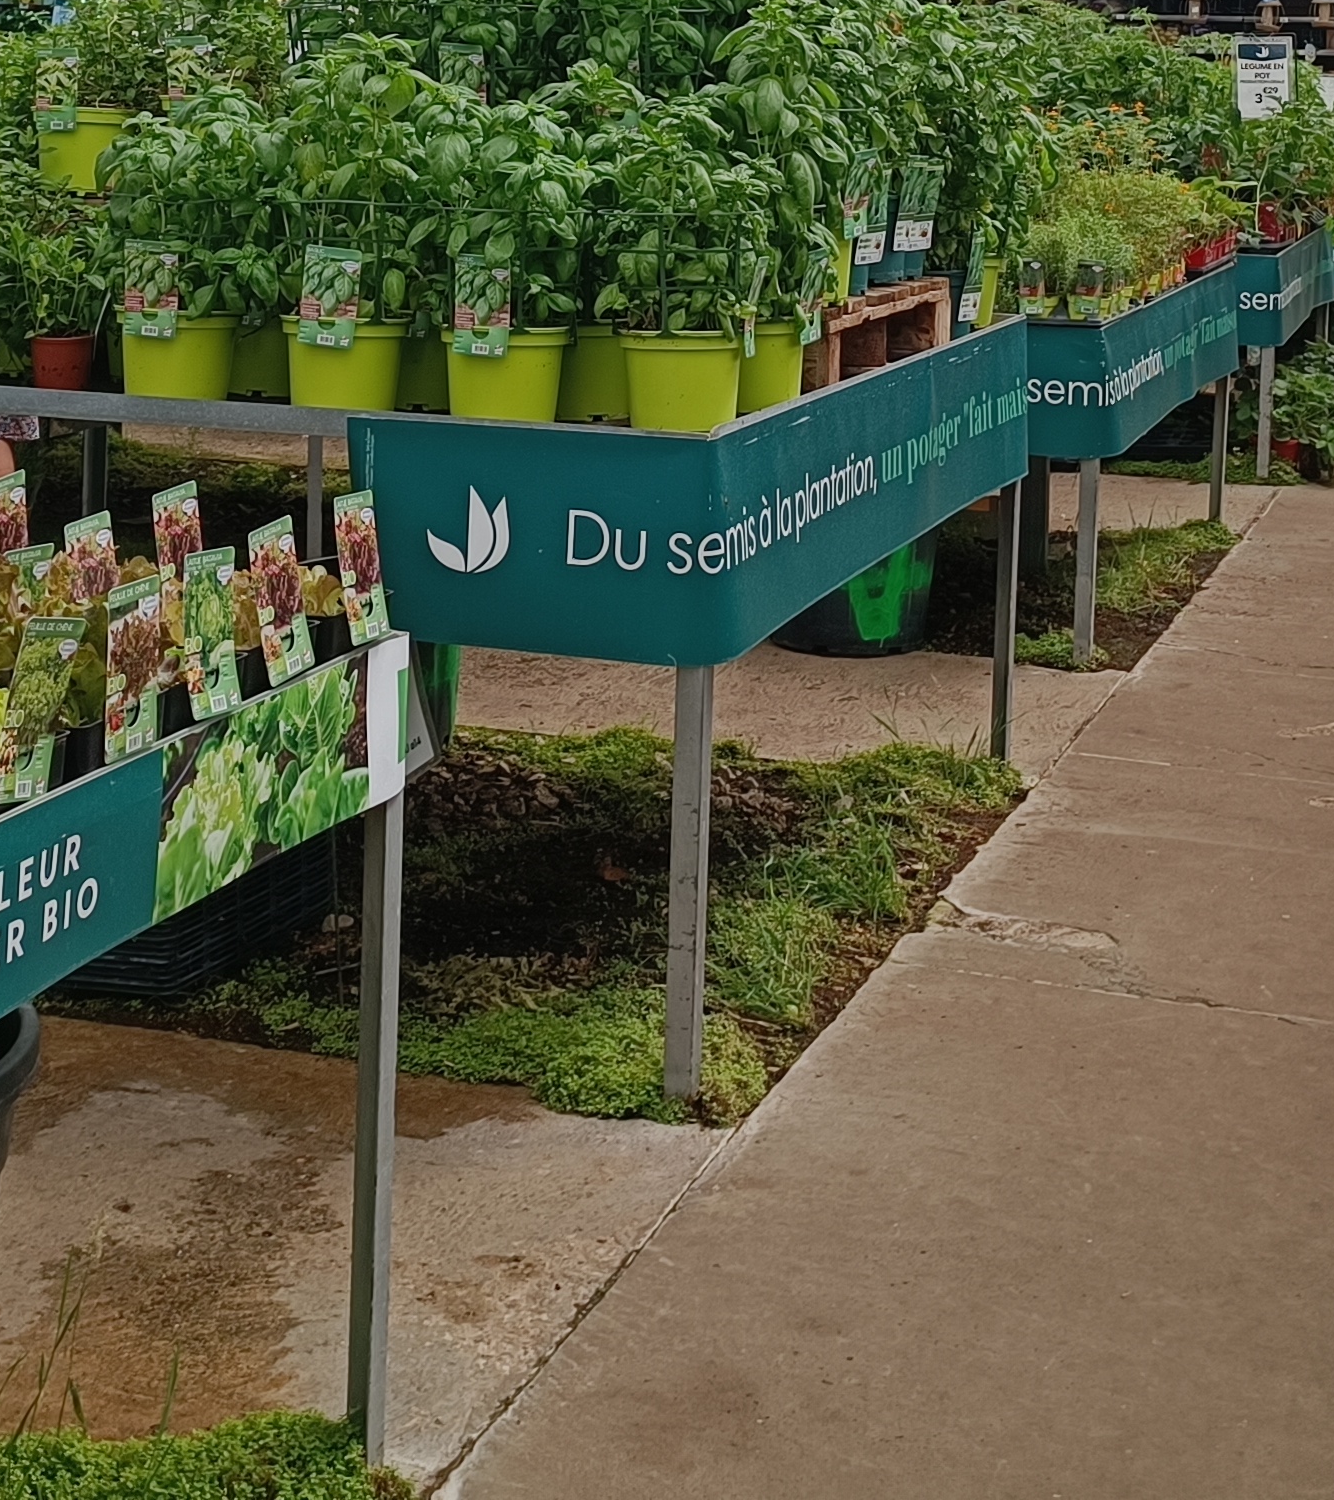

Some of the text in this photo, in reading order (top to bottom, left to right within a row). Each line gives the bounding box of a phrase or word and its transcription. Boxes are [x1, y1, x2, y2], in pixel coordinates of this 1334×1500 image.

[1255, 93, 1263, 104] 3
[565, 508, 648, 571] Du
[666, 505, 757, 576] semis
[759, 495, 772, 548] à
[776, 488, 793, 540] la
[794, 452, 879, 543] plantation,
[881, 445, 903, 484] un
[906, 412, 961, 485] potager
[160, 563, 177, 582] BIO
[342, 569, 356, 588] BIO
[260, 606, 274, 626] BIO
[185, 636, 202, 654] BIO
[108, 673, 126, 694] BIO
[5, 710, 25, 729] BIO
[42, 878, 99, 944] BIO
